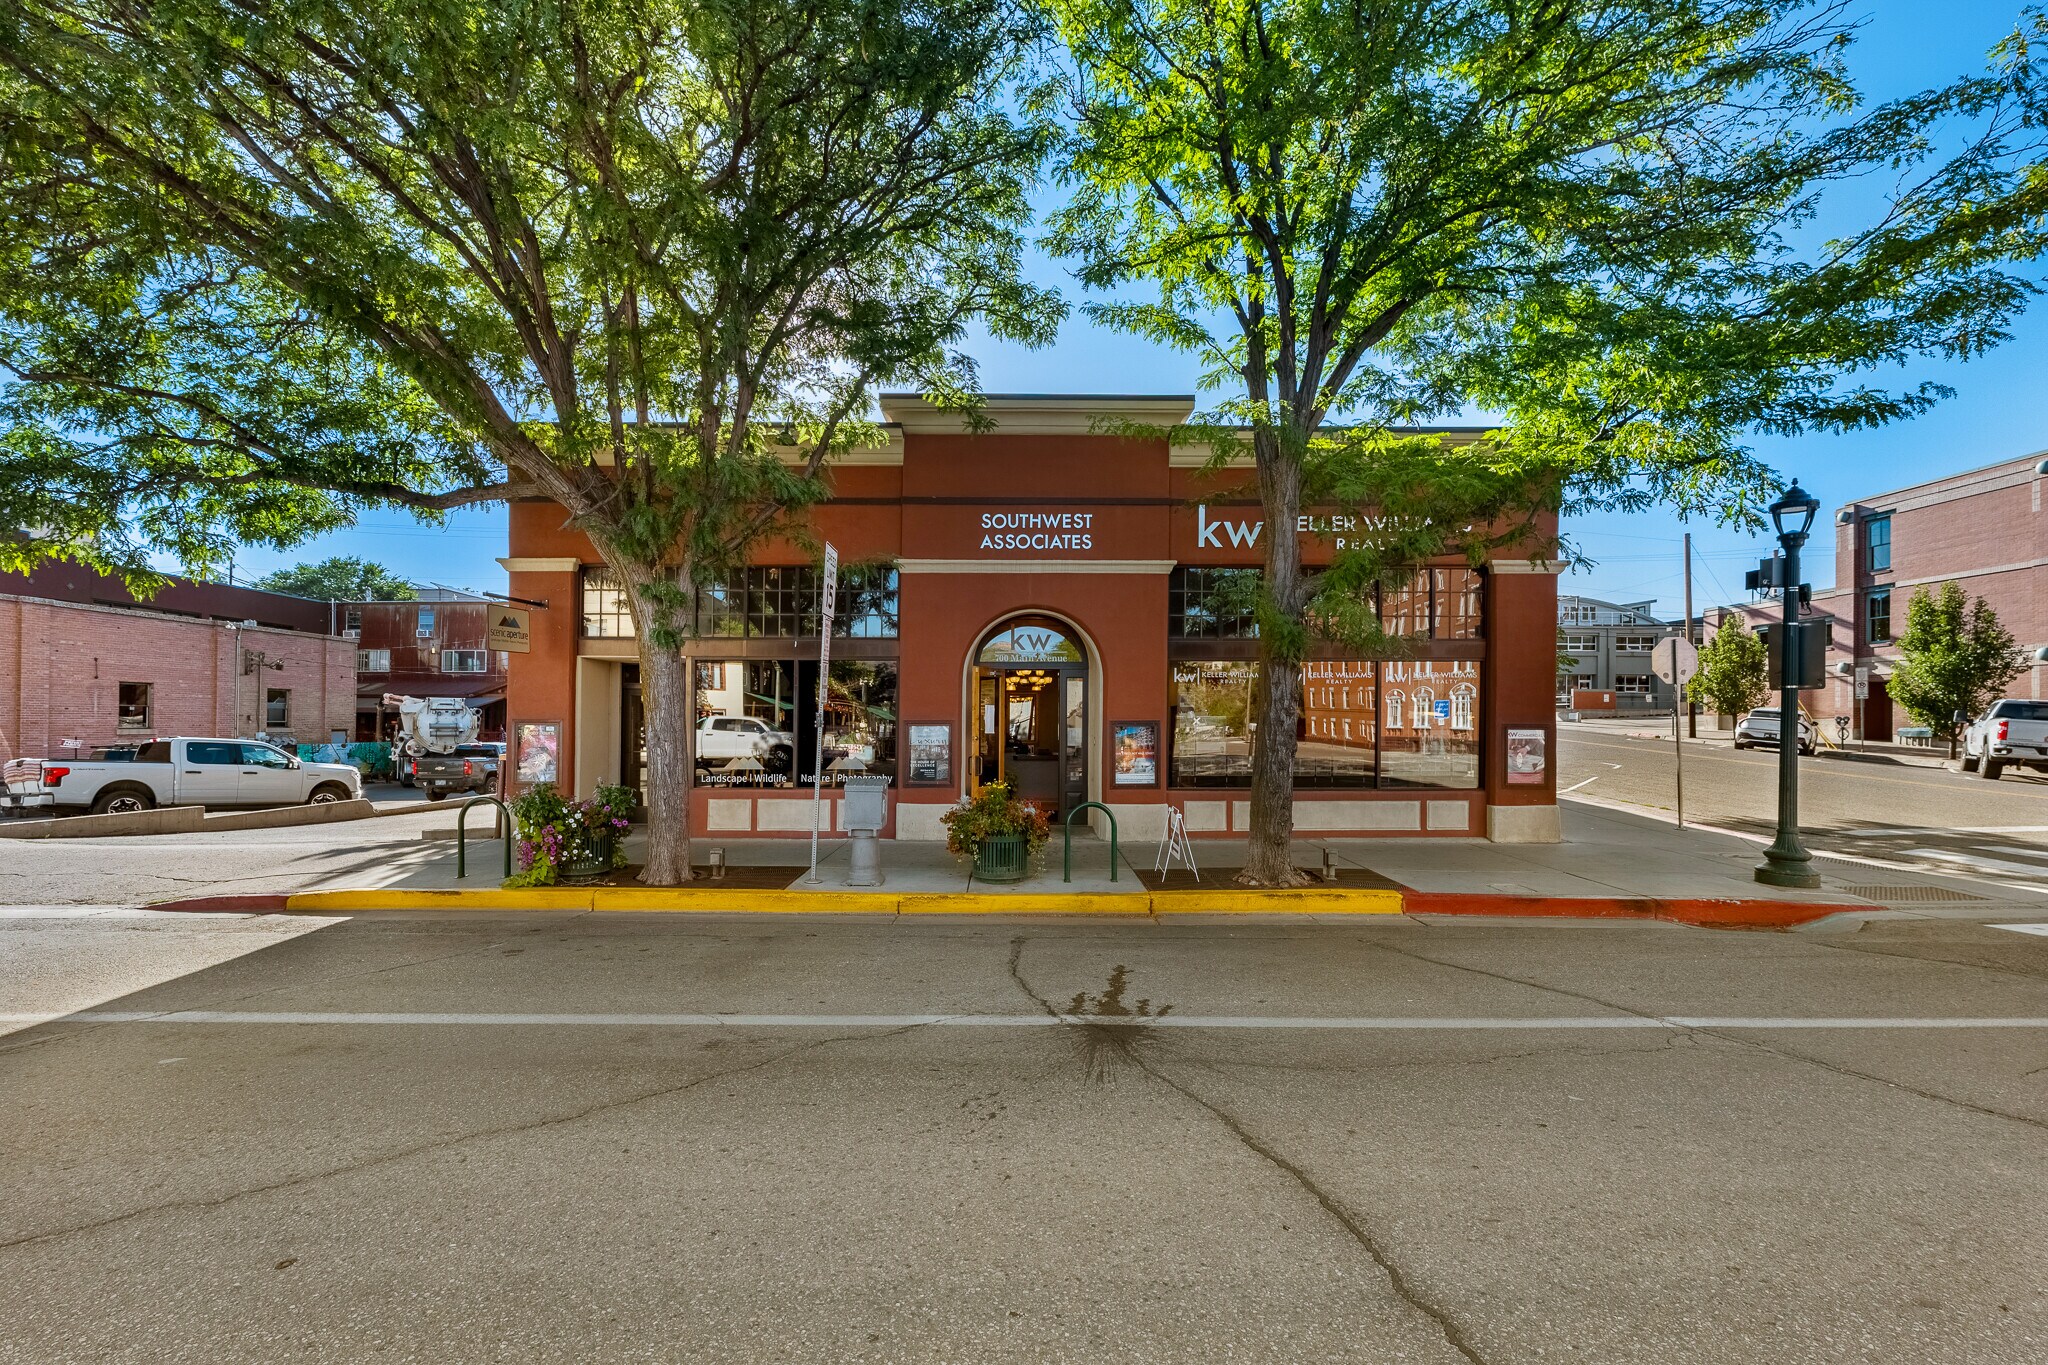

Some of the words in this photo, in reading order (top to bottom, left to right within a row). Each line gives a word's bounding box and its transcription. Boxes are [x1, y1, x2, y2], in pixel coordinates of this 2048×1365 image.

[981, 513, 1093, 529] SOUTHWEST
[1198, 504, 1265, 549] kw
[1297, 515, 1357, 532] ELLER
[980, 533, 1092, 549] ASSOCIATES
[826, 582, 834, 610] 15
[490, 627, 506, 638] scenic
[507, 630, 529, 640] aperture
[1010, 623, 1052, 651] kw
[995, 654, 1009, 662] 700
[1010, 654, 1034, 662] Main
[1035, 654, 1068, 662] Avenue
[1173, 667, 1197, 683] kw
[701, 773, 747, 785] Landscape
[754, 773, 787, 783] Wildlife
[800, 773, 831, 783] Natre
